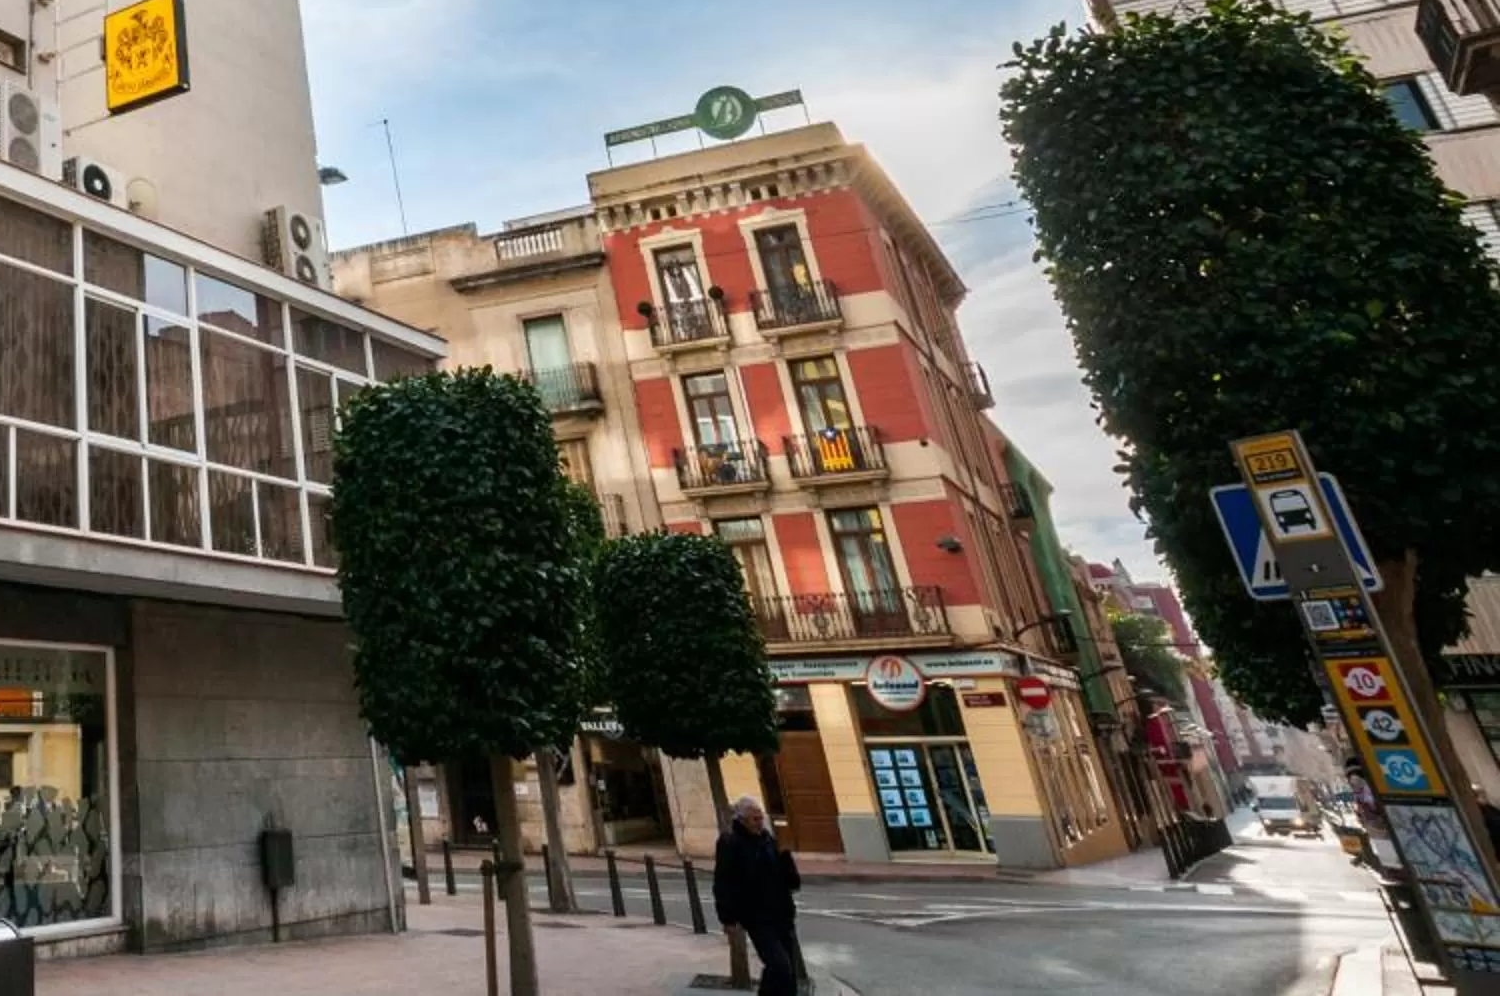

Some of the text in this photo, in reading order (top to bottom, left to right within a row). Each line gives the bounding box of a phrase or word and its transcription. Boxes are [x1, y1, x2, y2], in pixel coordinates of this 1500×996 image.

[1255, 452, 1288, 471] 219
[1352, 672, 1376, 690] 10
[1372, 716, 1396, 734] 42
[1388, 760, 1415, 778] 60
